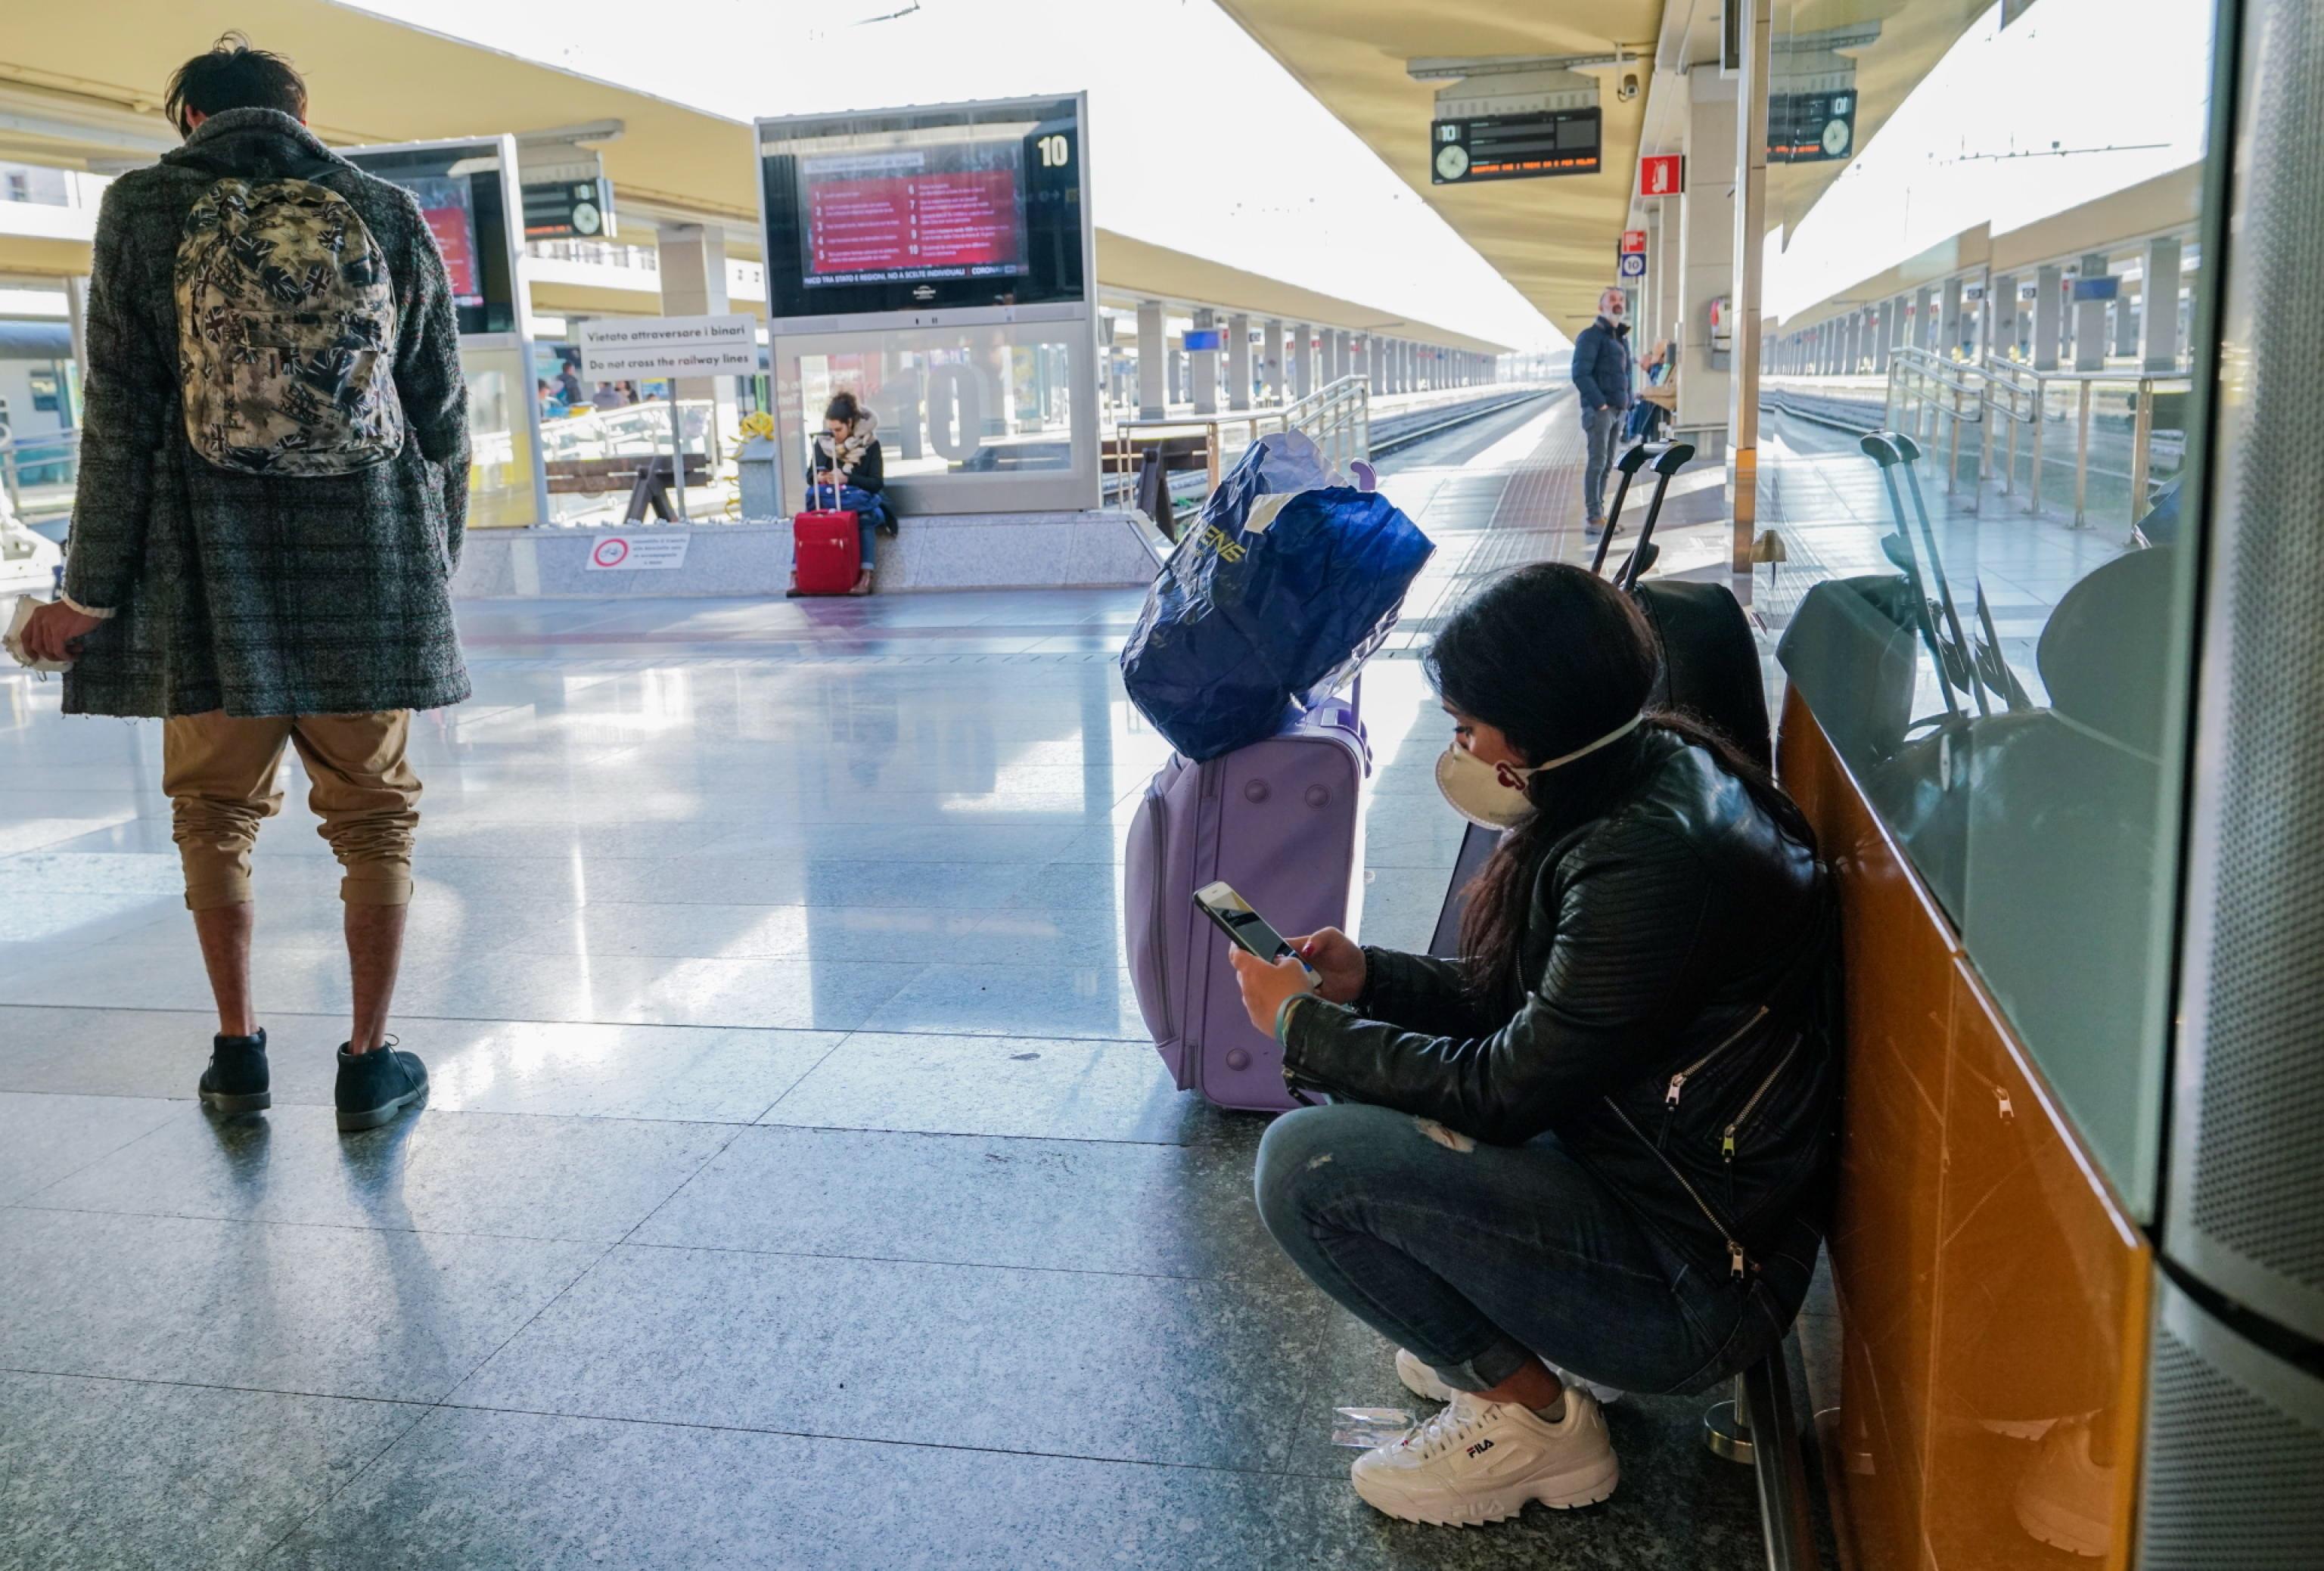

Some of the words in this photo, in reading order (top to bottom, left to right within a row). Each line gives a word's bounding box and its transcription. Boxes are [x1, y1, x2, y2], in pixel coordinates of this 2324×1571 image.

[1440, 125, 1456, 141] 10
[1038, 135, 1068, 167] 10
[909, 244, 919, 255] 10
[1627, 259, 1639, 270] 10
[587, 331, 628, 343] Vietato
[631, 327, 701, 341] attraversare
[711, 324, 745, 337] binari
[590, 359, 604, 370] Do
[607, 359, 626, 369] not
[628, 359, 654, 368] cross
[657, 356, 675, 367] the
[678, 355, 719, 368] railway
[722, 353, 749, 365] lines
[1466, 1439, 1494, 1458] FILA
[1451, 1498, 1505, 1518] FILA
